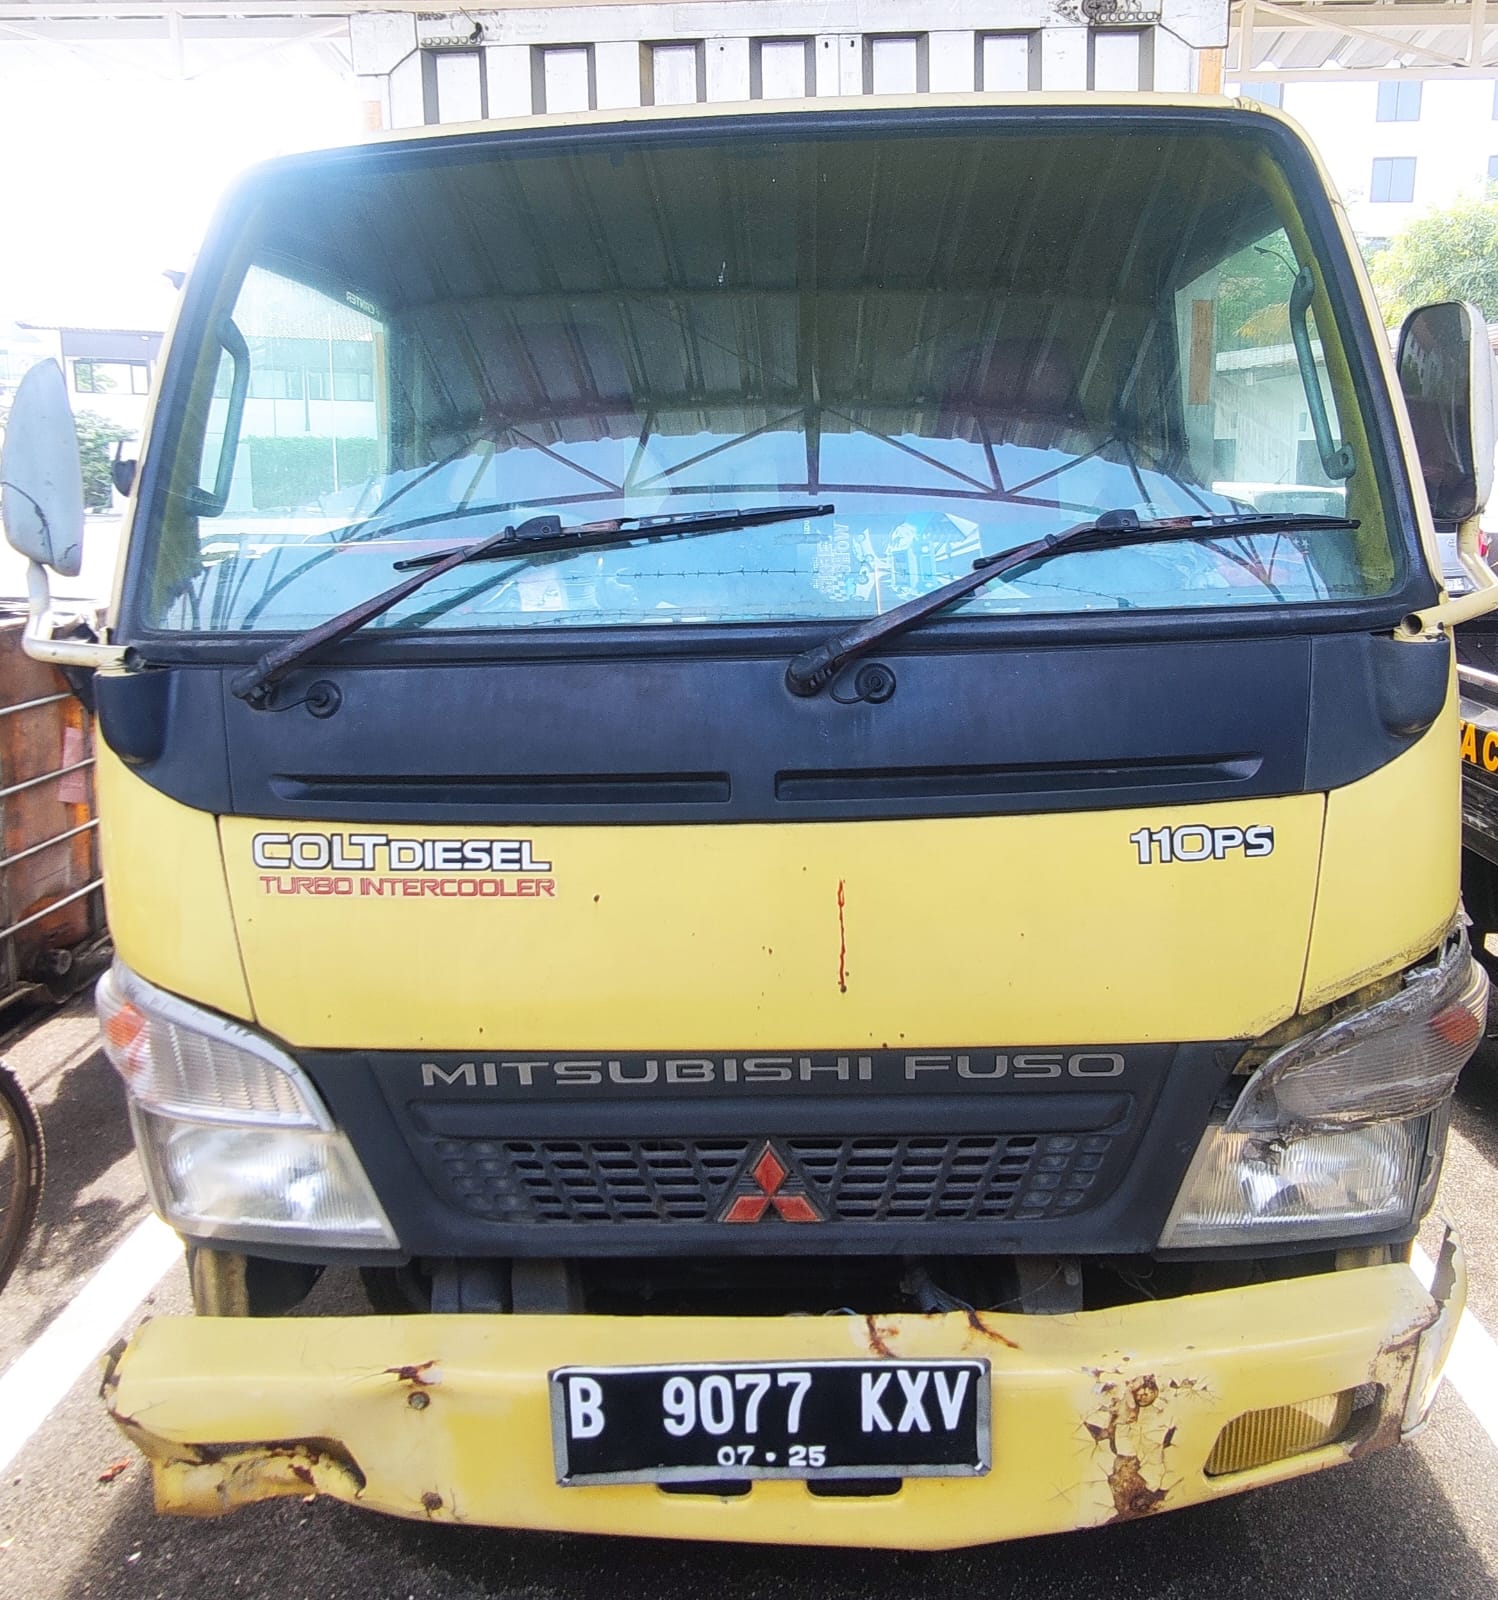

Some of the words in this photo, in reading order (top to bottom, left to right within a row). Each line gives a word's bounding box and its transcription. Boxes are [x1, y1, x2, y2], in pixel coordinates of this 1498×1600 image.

[1459, 719, 1498, 772] AC
[1130, 824, 1275, 865] 110PS
[259, 875, 353, 896] TURBO
[360, 877, 556, 898] INTERCOOLER
[421, 1057, 874, 1086] MITSUBISHI
[904, 1053, 1125, 1080] FUSO
[568, 1376, 606, 1439] B
[662, 1372, 812, 1436] 9077
[860, 1369, 971, 1433] KXV
